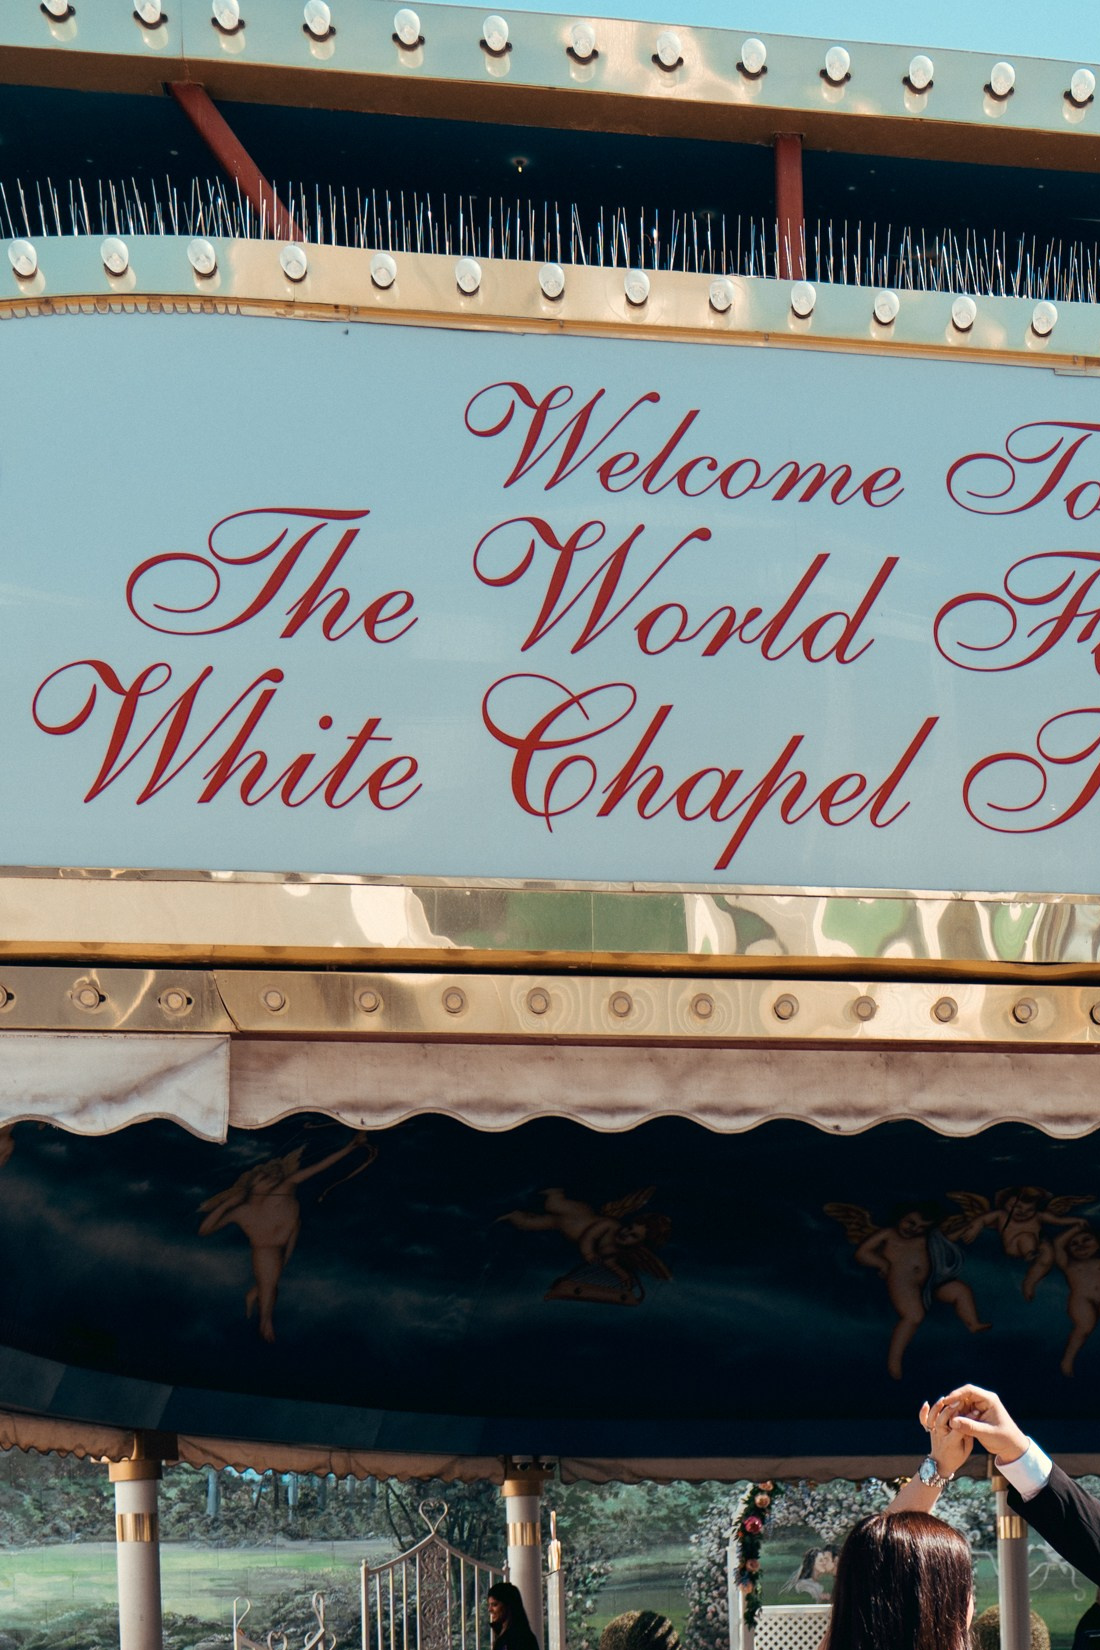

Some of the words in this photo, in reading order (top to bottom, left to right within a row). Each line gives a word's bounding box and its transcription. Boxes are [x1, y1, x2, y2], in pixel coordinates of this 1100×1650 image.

[464, 381, 904, 507] Welcome
[125, 507, 418, 643] The
[472, 516, 900, 664] World
[31, 659, 423, 810] White
[481, 672, 939, 870] Chapel
